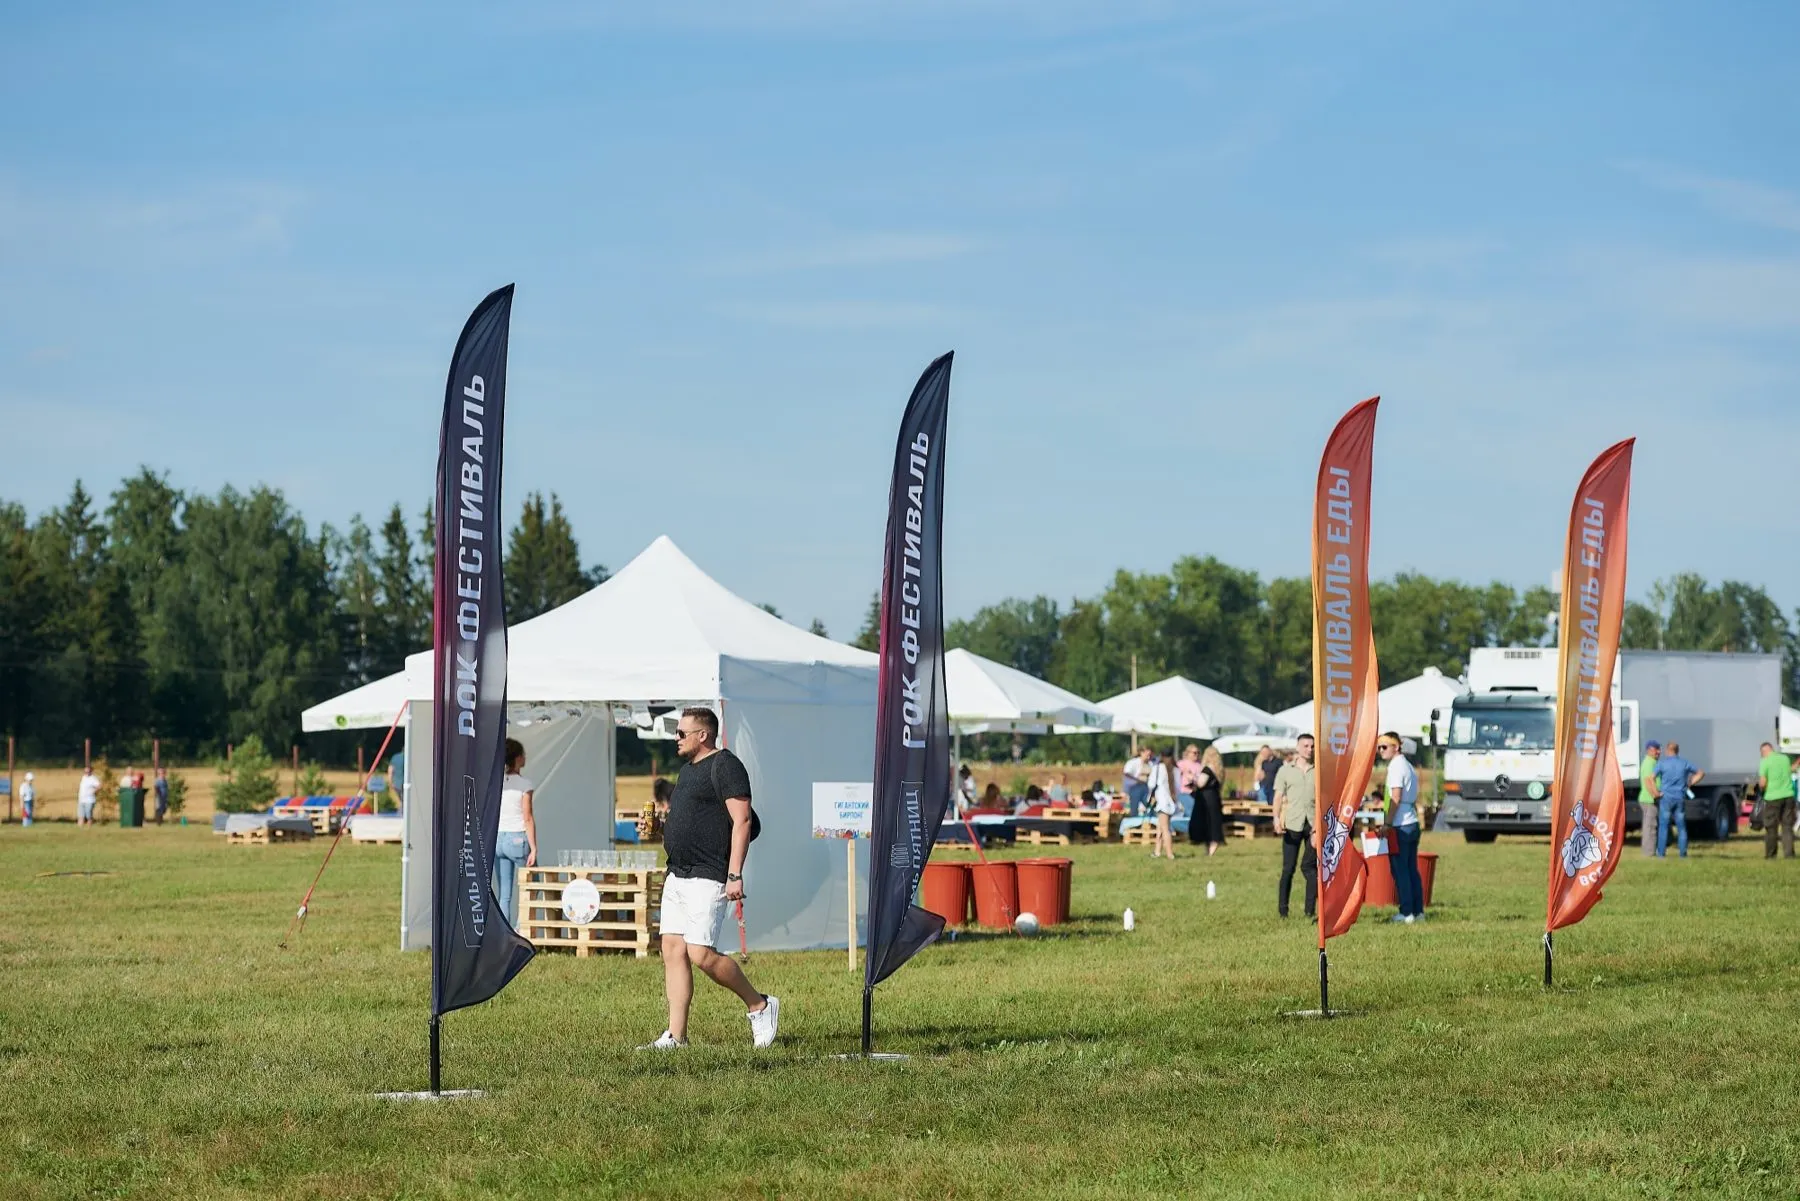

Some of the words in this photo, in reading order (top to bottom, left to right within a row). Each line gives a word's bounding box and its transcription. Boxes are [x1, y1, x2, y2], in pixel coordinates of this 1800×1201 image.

[456, 374, 486, 642] ФЕСТИВАЛЬ
[1328, 467, 1351, 544] ЕДЫ
[1579, 497, 1606, 570] ЕДЫ
[901, 431, 929, 664] ФЕСТИВАЛЬ
[456, 652, 478, 738] РОК
[1326, 553, 1352, 755] ФЕСТИВАЛЬ
[1575, 577, 1601, 759] ФЕСТИВАЛЬ
[901, 673, 927, 749] РОК
[905, 789, 922, 869] ПЯТНИЦ
[467, 881, 485, 937] СЕМЬ
